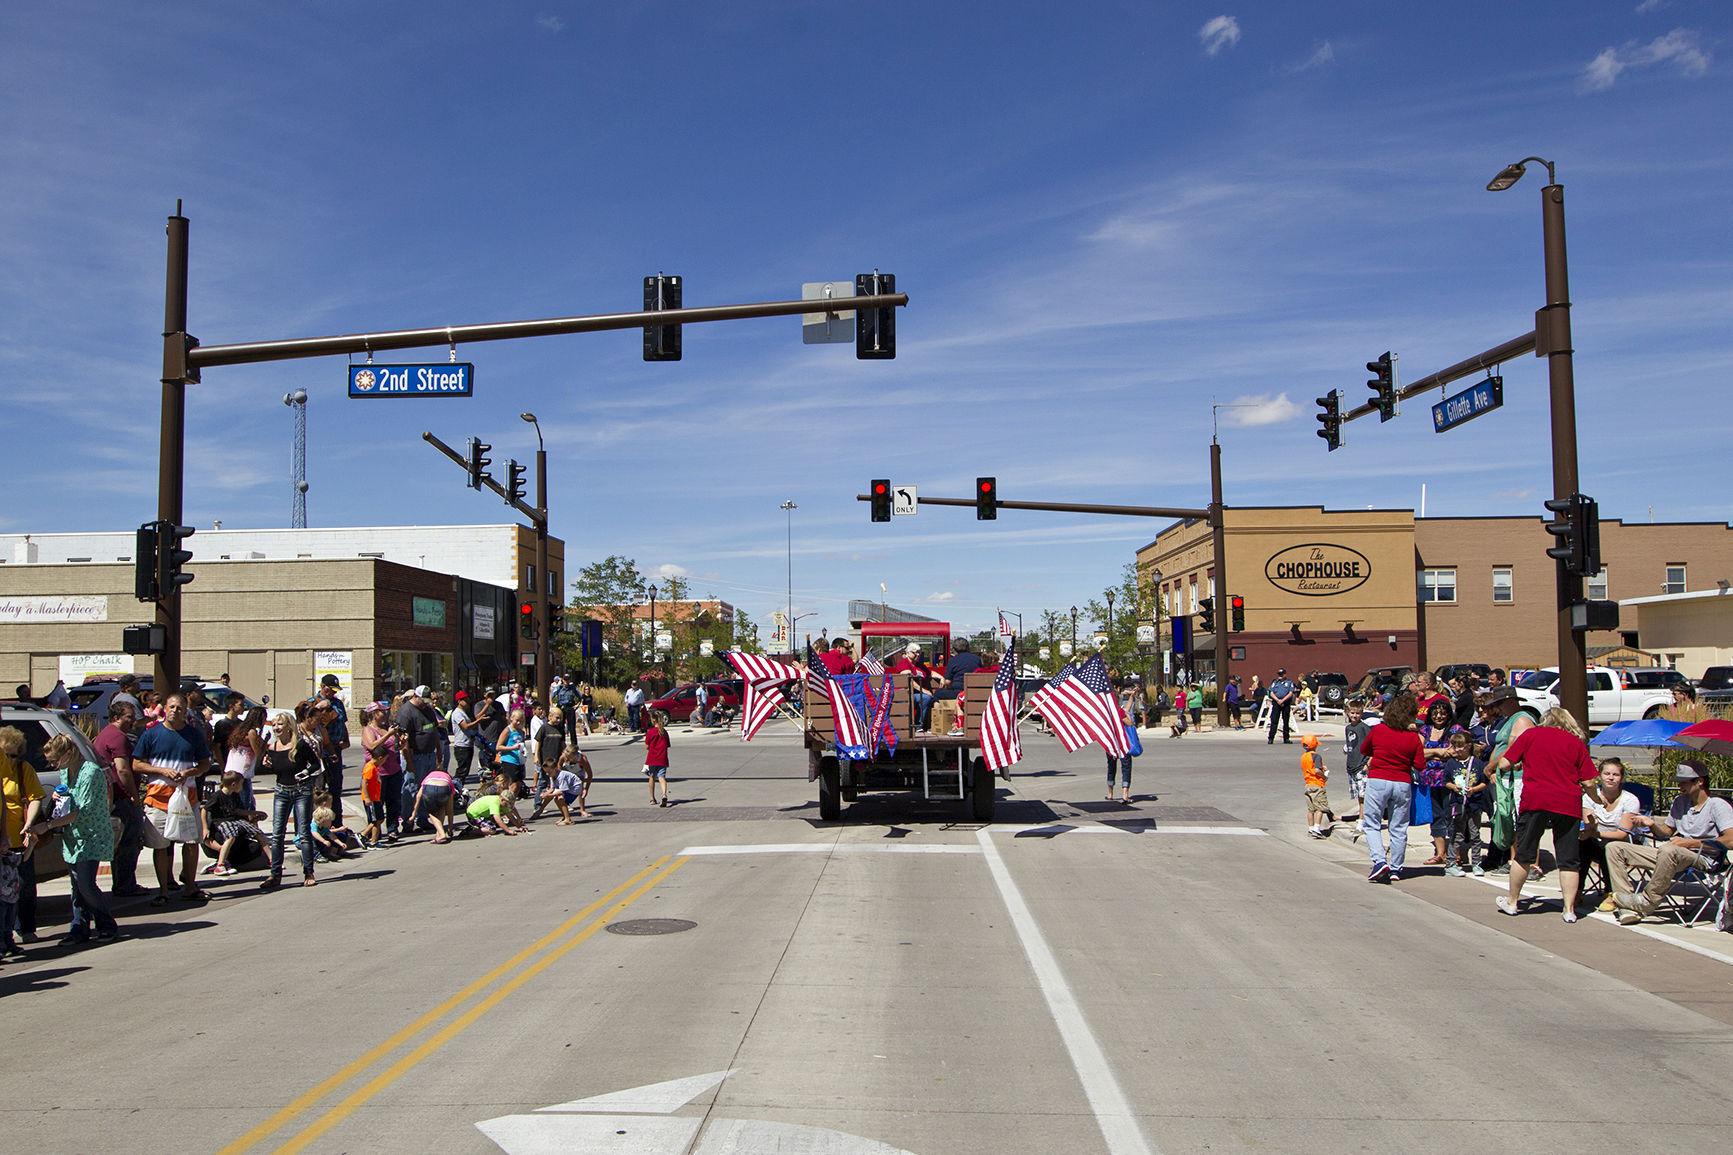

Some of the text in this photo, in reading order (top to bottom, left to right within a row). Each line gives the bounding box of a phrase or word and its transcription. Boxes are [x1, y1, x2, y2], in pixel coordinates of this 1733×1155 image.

[379, 368, 464, 391] 2nd Street
[1446, 390, 1488, 422] Gillette Ave
[1310, 547, 1325, 560] The
[1277, 562, 1360, 578] CHOPHOUSE
[1297, 579, 1341, 590] Restaurant
[0, 601, 22, 618] day
[71, 655, 122, 666] HOP Chalk
[328, 657, 350, 665] Pottery
[881, 682, 890, 709] America
